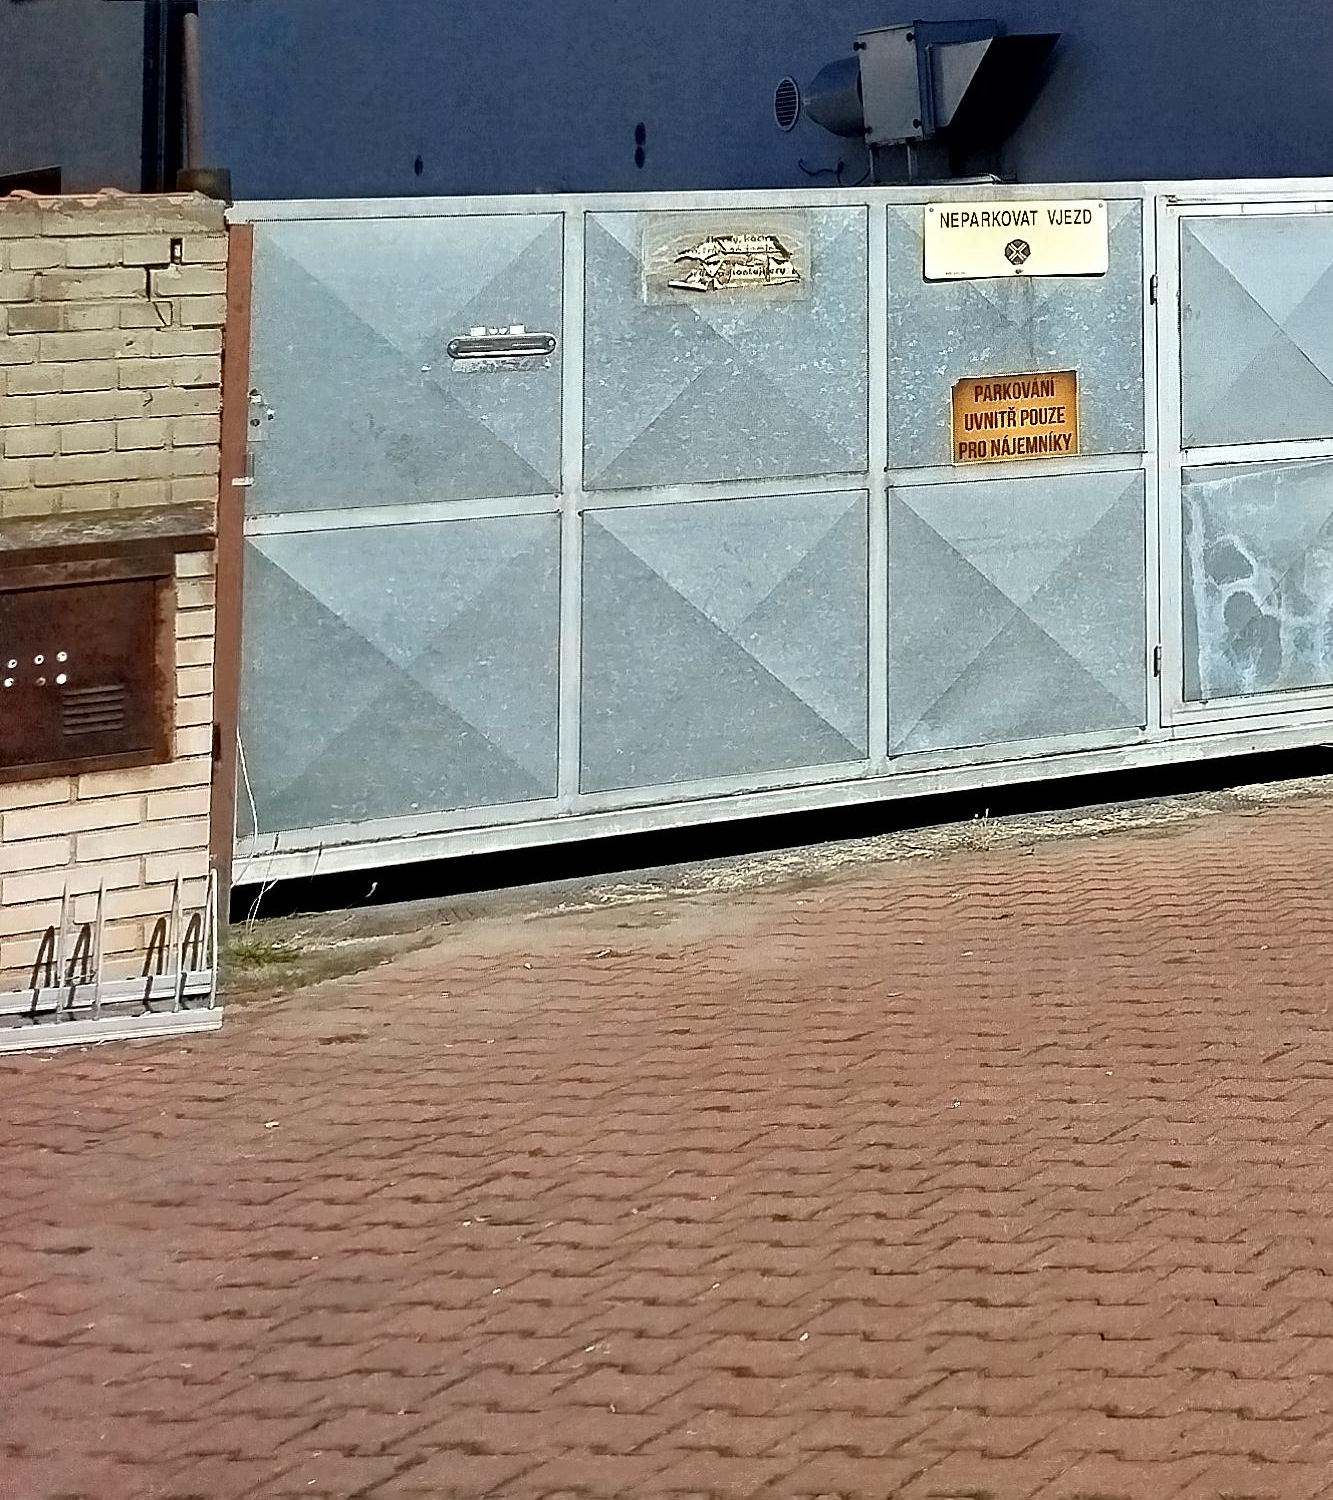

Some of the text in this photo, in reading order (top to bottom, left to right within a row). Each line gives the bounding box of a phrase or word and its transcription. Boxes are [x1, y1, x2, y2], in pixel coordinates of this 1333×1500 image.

[940, 209, 1093, 229] NEPARKOVAT VJEZD
[974, 376, 1055, 403] PARKOVÁNÍ
[964, 406, 1066, 431] UVNITŘ POUZE
[959, 430, 1072, 460] PRO NÁJEMNÍKY
